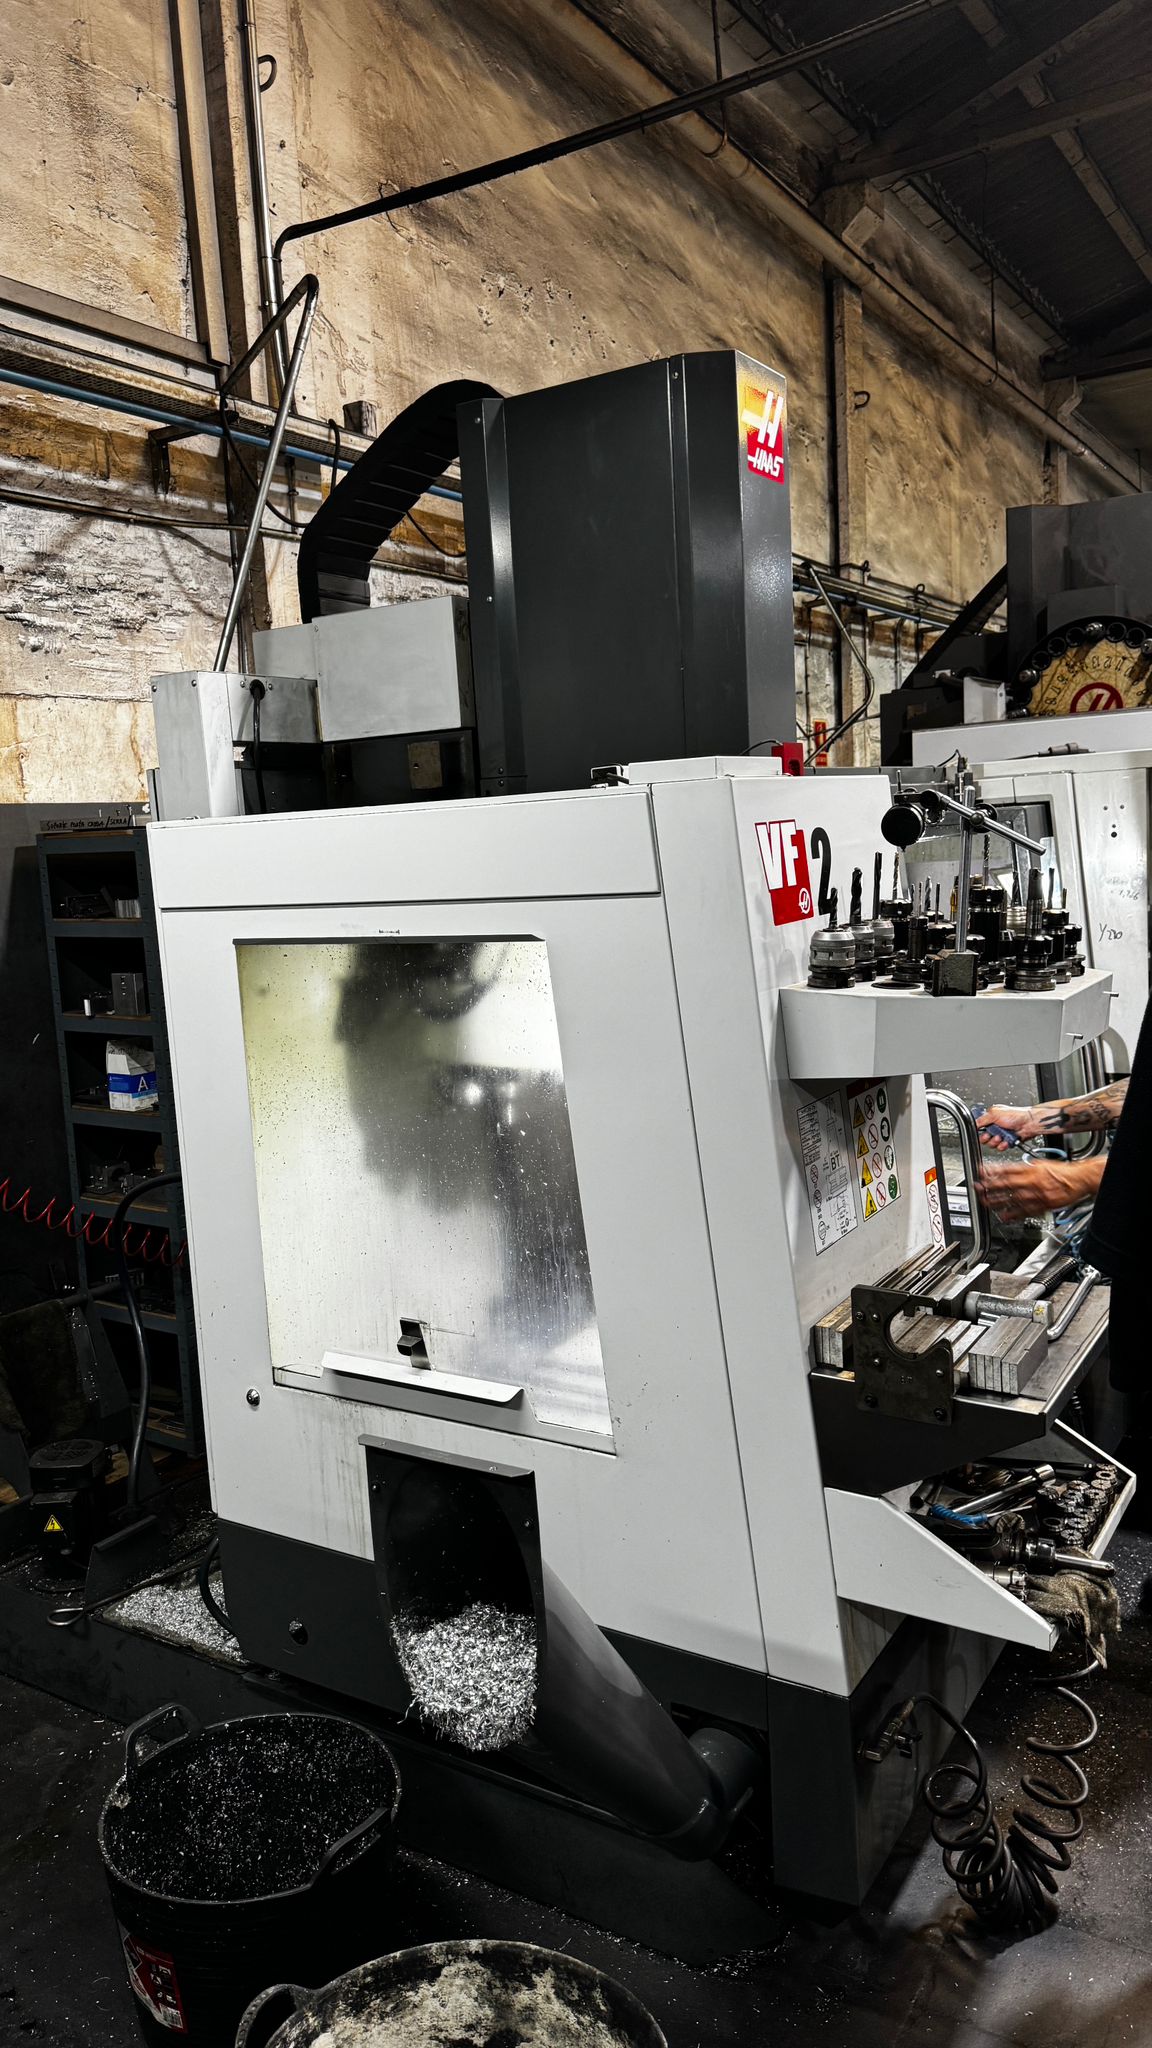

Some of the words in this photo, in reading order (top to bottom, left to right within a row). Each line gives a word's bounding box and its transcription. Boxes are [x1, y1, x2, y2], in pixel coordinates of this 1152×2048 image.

[747, 447, 784, 477] HAAS
[1091, 655, 1101, 669] 13
[1103, 655, 1113, 669] 12
[754, 819, 798, 890] VF
[831, 1154, 840, 1170] BT
